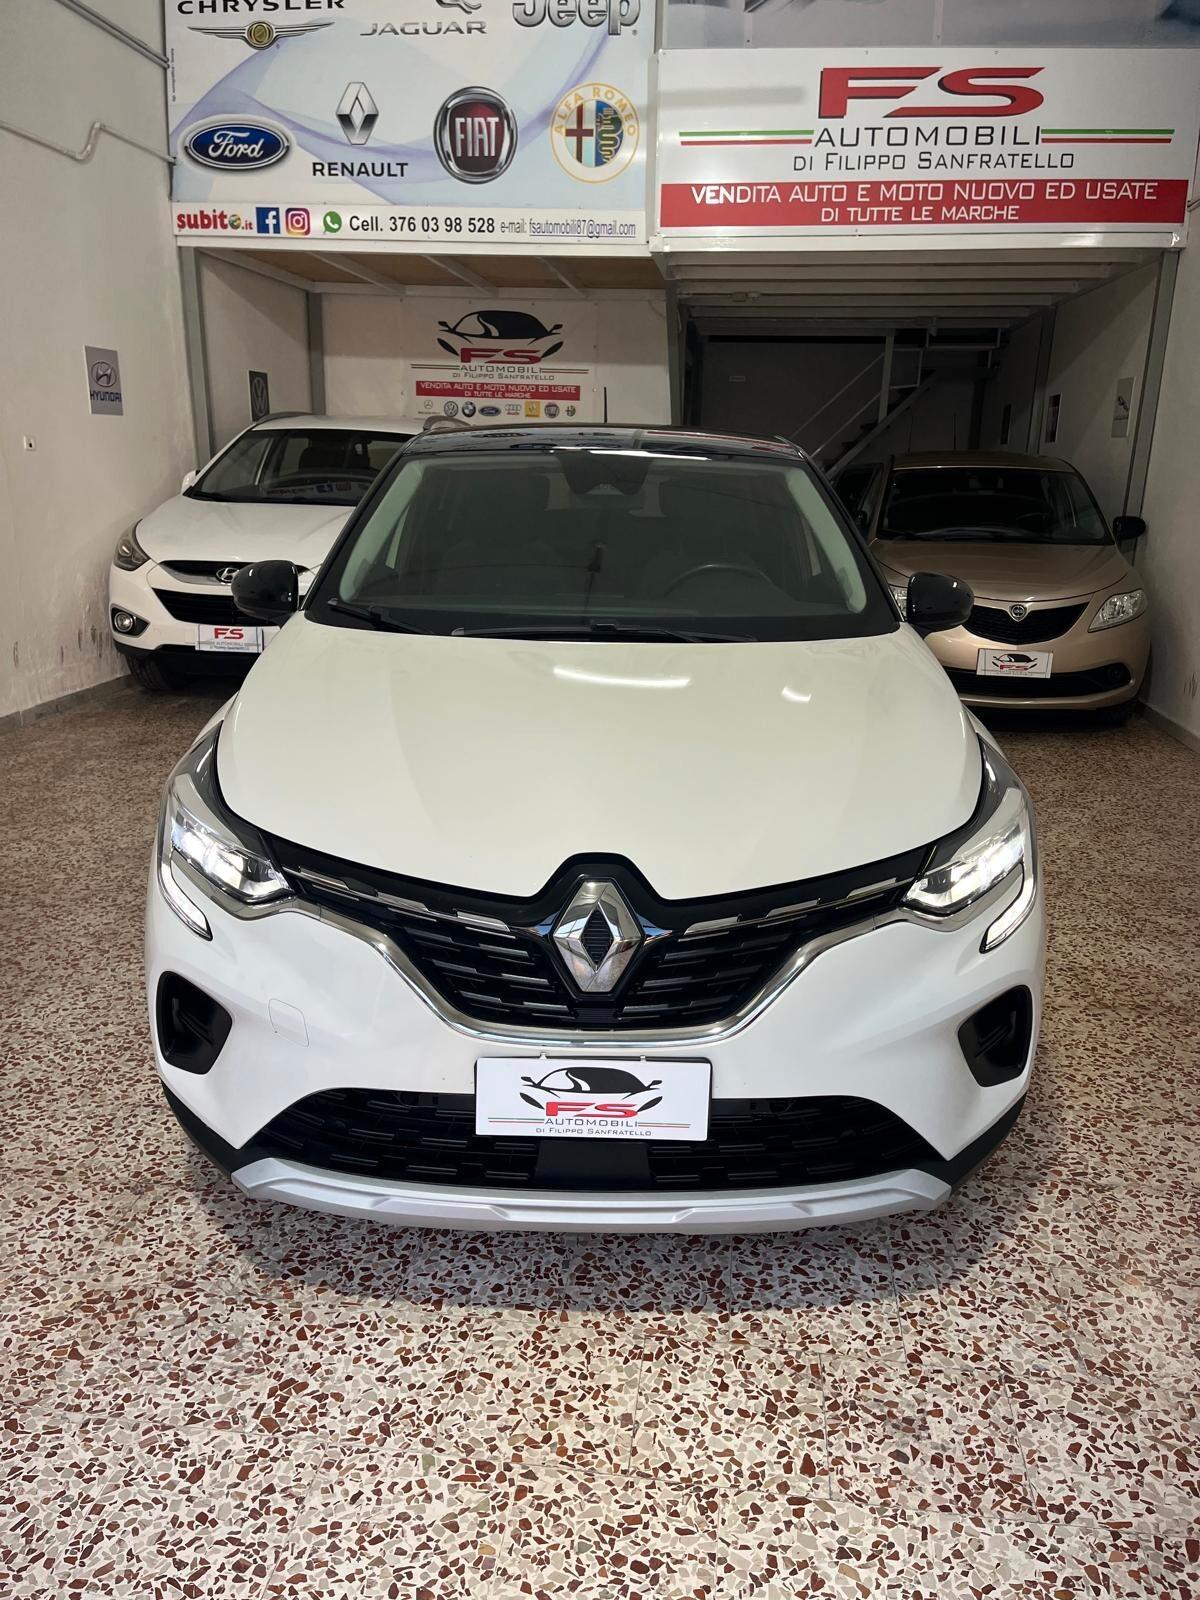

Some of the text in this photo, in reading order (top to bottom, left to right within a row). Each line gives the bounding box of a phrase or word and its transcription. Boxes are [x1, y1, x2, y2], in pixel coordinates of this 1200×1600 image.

[177, 0, 345, 14] CHRYSLER
[512, 0, 640, 36] Jeep
[360, 21, 487, 36] JAGUAR
[818, 67, 1045, 119] FS
[554, 87, 637, 136] ALFA ROMEO
[208, 130, 265, 158] Ford
[455, 117, 499, 158] FIAT
[814, 126, 1041, 148] AUTOMOBILI
[794, 151, 1074, 171] DI FILIPPO SANFRATELLO
[312, 162, 409, 178] RENAULT
[691, 182, 1159, 204] VENDITA AUTO E MOTO NUOVO ED USATE
[176, 209, 253, 230] subito.it
[821, 205, 1020, 222] DI TUTTE LE MARCHE
[349, 215, 384, 232] Cell.
[389, 216, 416, 232] 376
[421, 216, 440, 233] 03
[444, 217, 463, 233] 98
[468, 217, 495, 234] 528
[461, 348, 542, 364] FS
[460, 365, 542, 374] AUTOMOBILI
[420, 382, 451, 390] VENDITA
[508, 384, 536, 392] NUOVO
[213, 627, 244, 640] FS
[546, 1102, 638, 1118] FS
[545, 1118, 638, 1127] AUTOMOBILI
[549, 1127, 584, 1135] FILIPPO
[587, 1128, 652, 1136] SANFRATELLO
